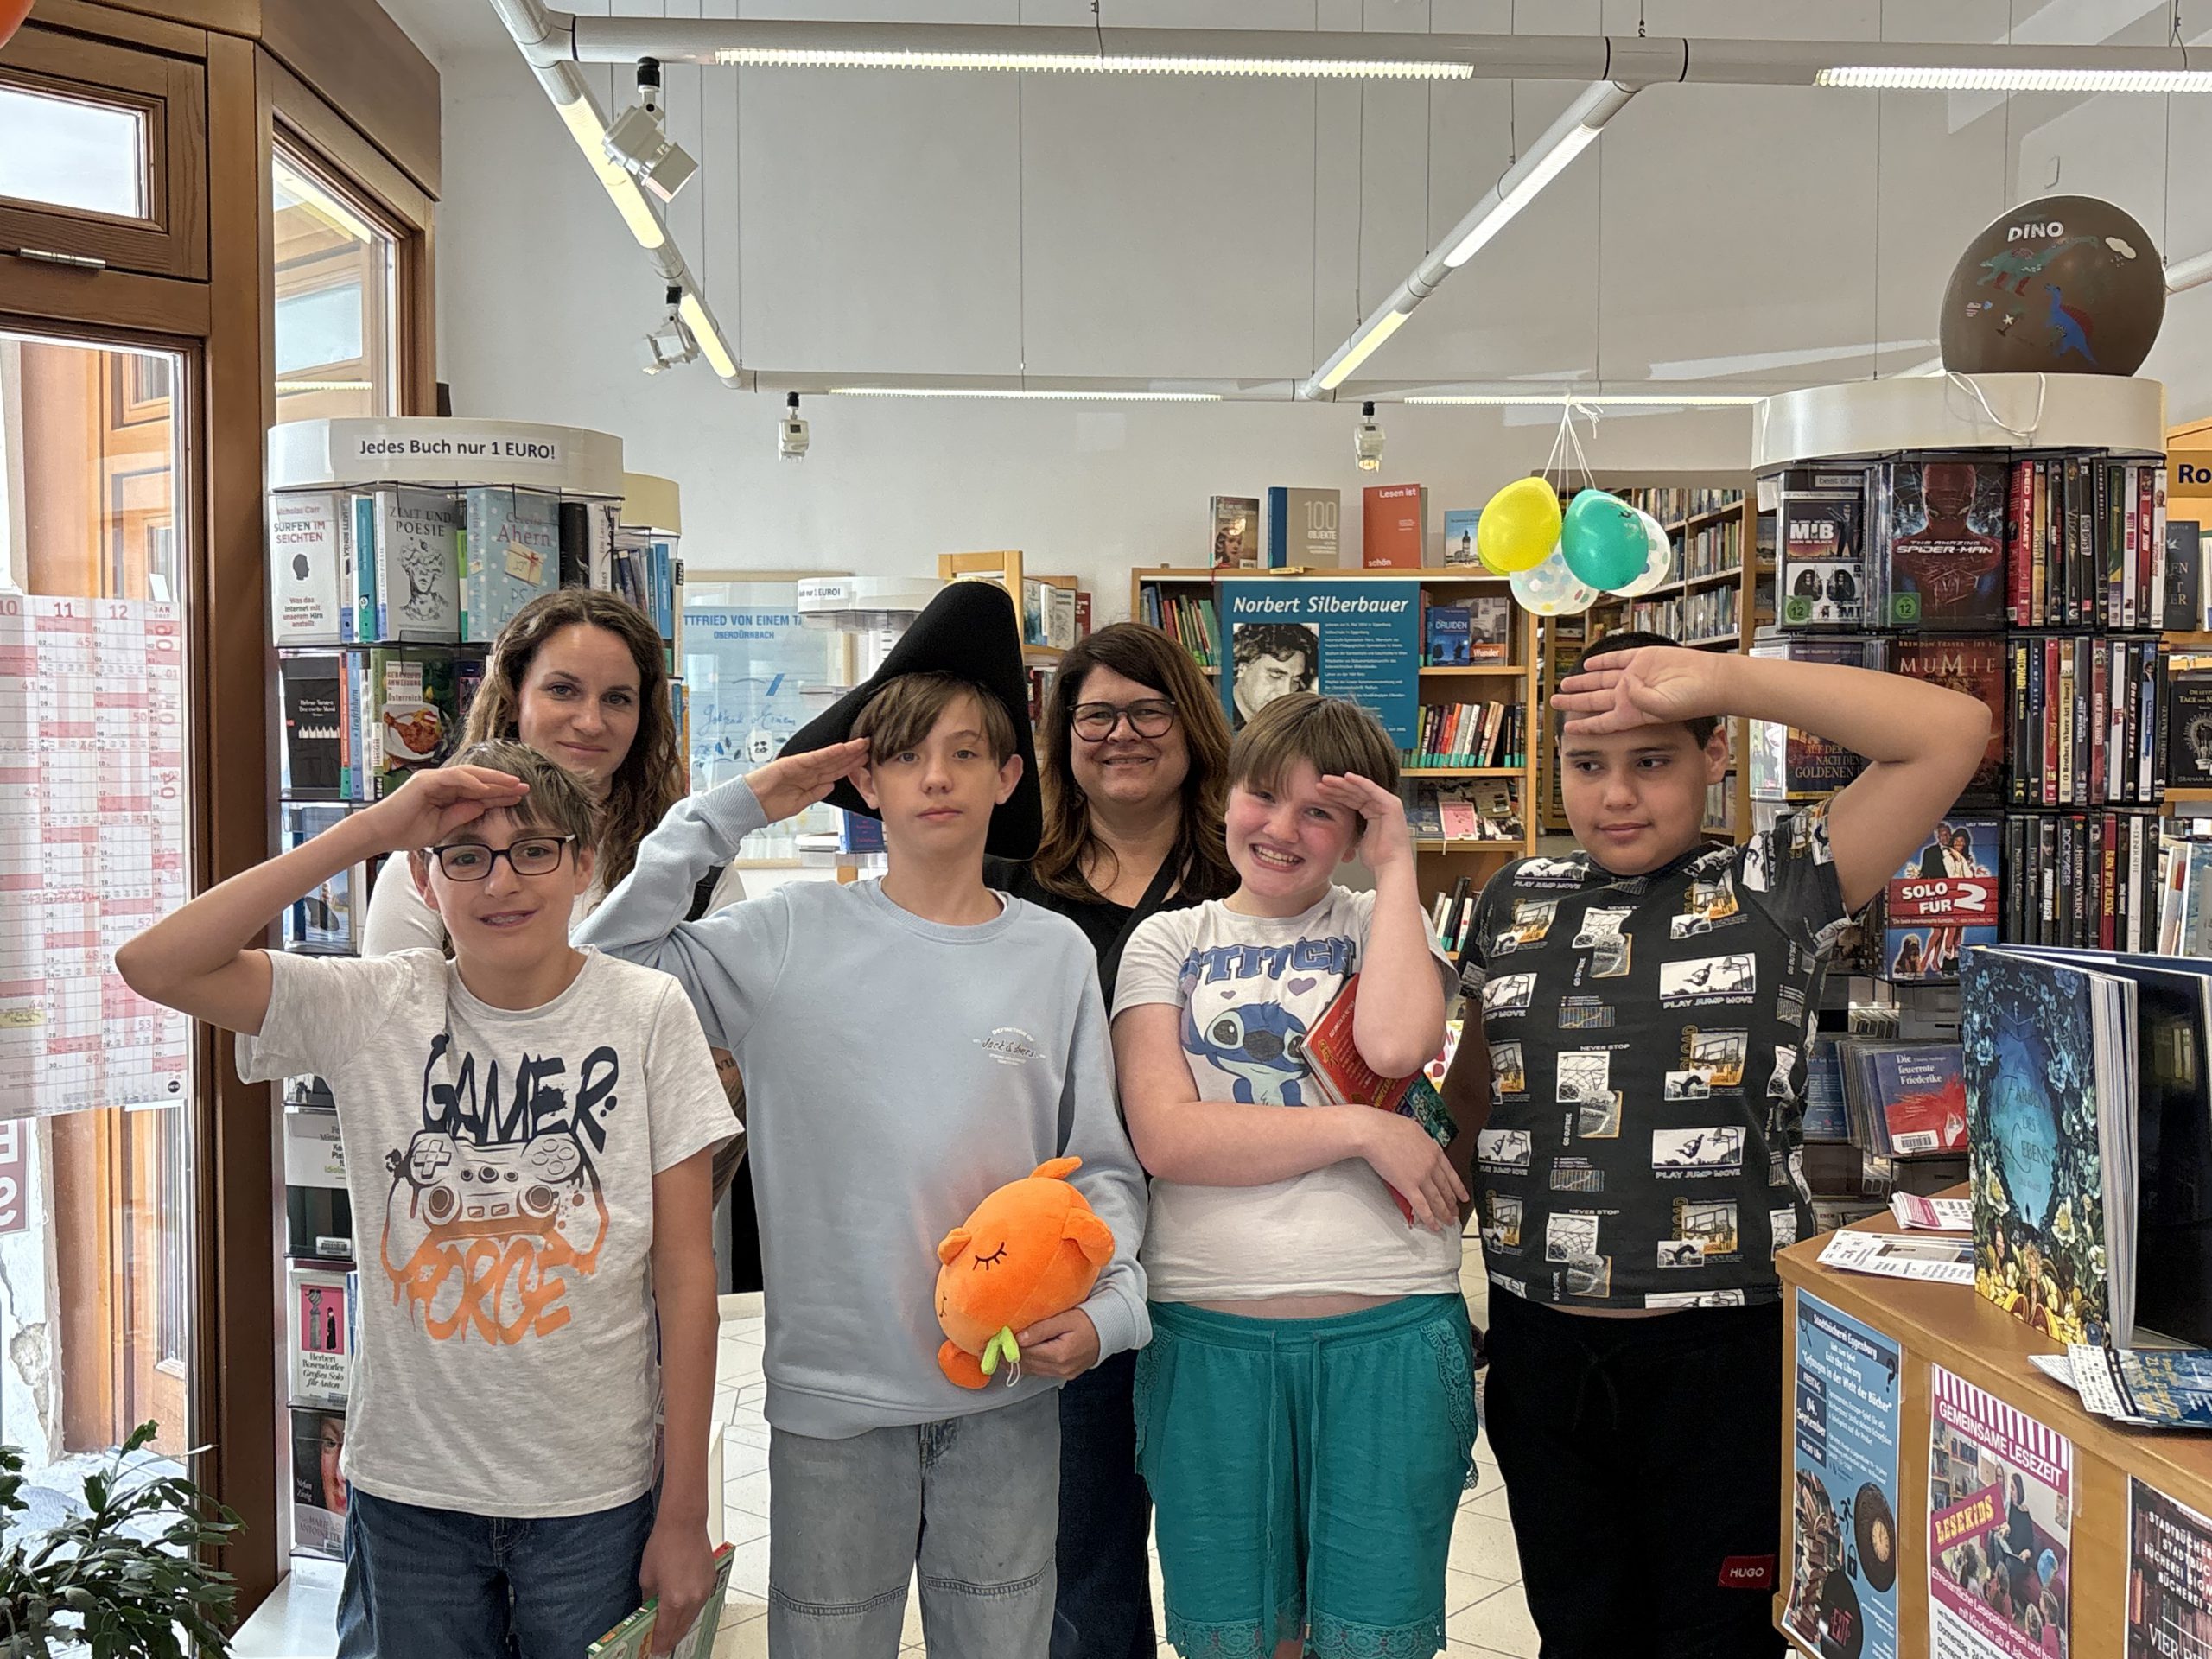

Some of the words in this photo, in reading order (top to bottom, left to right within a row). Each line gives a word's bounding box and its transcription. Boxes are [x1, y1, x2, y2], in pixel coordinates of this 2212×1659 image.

[2007, 221, 2064, 242] DINO
[359, 439, 404, 455] Jedes
[410, 439, 451, 454] Buch
[456, 442, 486, 455] nur
[491, 441, 501, 455] 1
[505, 442, 556, 460] EURO!
[2179, 464, 2212, 483] Ro
[1380, 488, 1404, 498] Lesen
[390, 507, 423, 518] ZIMT
[425, 511, 451, 523] UND
[1304, 501, 1337, 530] 100
[274, 521, 311, 532] SURFEN
[313, 520, 326, 530] IM
[396, 521, 445, 537] POESIE
[2021, 499, 2031, 550] PLANET
[276, 532, 323, 544] SEICHTEN
[497, 524, 551, 547] Ahern
[1307, 531, 1337, 539] OBJEKTE
[1897, 545, 1993, 555] SPIDER-MAN
[1369, 558, 1391, 567] schön
[818, 588, 841, 597] EURO!
[54, 602, 74, 618] 11
[109, 604, 129, 620] 12
[1233, 596, 1300, 613] Norbert
[1307, 595, 1409, 613] Silberbauer
[1791, 607, 1804, 616] 12
[1900, 604, 1913, 614] 12
[683, 614, 727, 626] TTFRIED
[731, 614, 753, 626] VON
[756, 614, 789, 626] EINEM
[1900, 654, 1996, 677] MUMIE
[2017, 648, 2026, 690] WATCHMEN
[388, 692, 422, 702] Österreich
[2128, 682, 2137, 718] GHOST
[1806, 745, 1823, 754] AUF
[1826, 744, 1843, 753] DER
[1815, 755, 1840, 765] NACH
[1795, 766, 1854, 778] GOLDENEN
[2063, 829, 2071, 856] ROCK
[2075, 849, 2084, 879] HISTORY
[1902, 882, 1948, 899] SOLO
[1954, 882, 1987, 912] 2
[2075, 887, 2083, 919] VIOLENCE
[1919, 897, 1953, 915] FÜR
[1663, 999, 1692, 1009] PLAY
[1694, 997, 1724, 1006] JUMP
[1726, 995, 1753, 1004] MOVE
[1897, 1054, 1911, 1064] Die
[1898, 1065, 1936, 1074] feuerrote
[1900, 1075, 1942, 1085] Friederike
[423, 1034, 619, 1154] GAMER
[1656, 1169, 1683, 1179] PLAY
[1813, 1314, 1847, 1341] Stadtbücherei
[1847, 1333, 1878, 1361] Eggenburg
[310, 1353, 335, 1363] Herbert
[1825, 1351, 1834, 1363] Exit
[1834, 1357, 1843, 1369] the
[1843, 1361, 1861, 1382] Library
[306, 1378, 318, 1388] für
[321, 1380, 340, 1389] Anton
[1827, 1365, 1832, 1378] in
[1833, 1369, 1841, 1384] der
[1842, 1376, 1856, 1394] Welt
[1857, 1384, 1867, 1400] der
[1797, 1408, 1826, 1437] September
[1939, 1401, 2007, 1455] GEMEINSAME
[2008, 1440, 2063, 1487] LESEZEIT
[2144, 1542, 2184, 1580] BÜCHEREI
[1729, 1567, 1764, 1578] HUGO
[2158, 1571, 2203, 1610] BÜCHEREI
[1931, 1567, 1974, 1607] Ehrenamtliche
[1974, 1599, 2008, 1631] Lesepaten
[2008, 1623, 2027, 1646] lesen
[2027, 1639, 2041, 1657] und
[1958, 1606, 1969, 1621] mit
[1969, 1613, 1994, 1641] Kindern
[1994, 1634, 2005, 1648] ab
[2148, 1623, 2179, 1659] VIER
